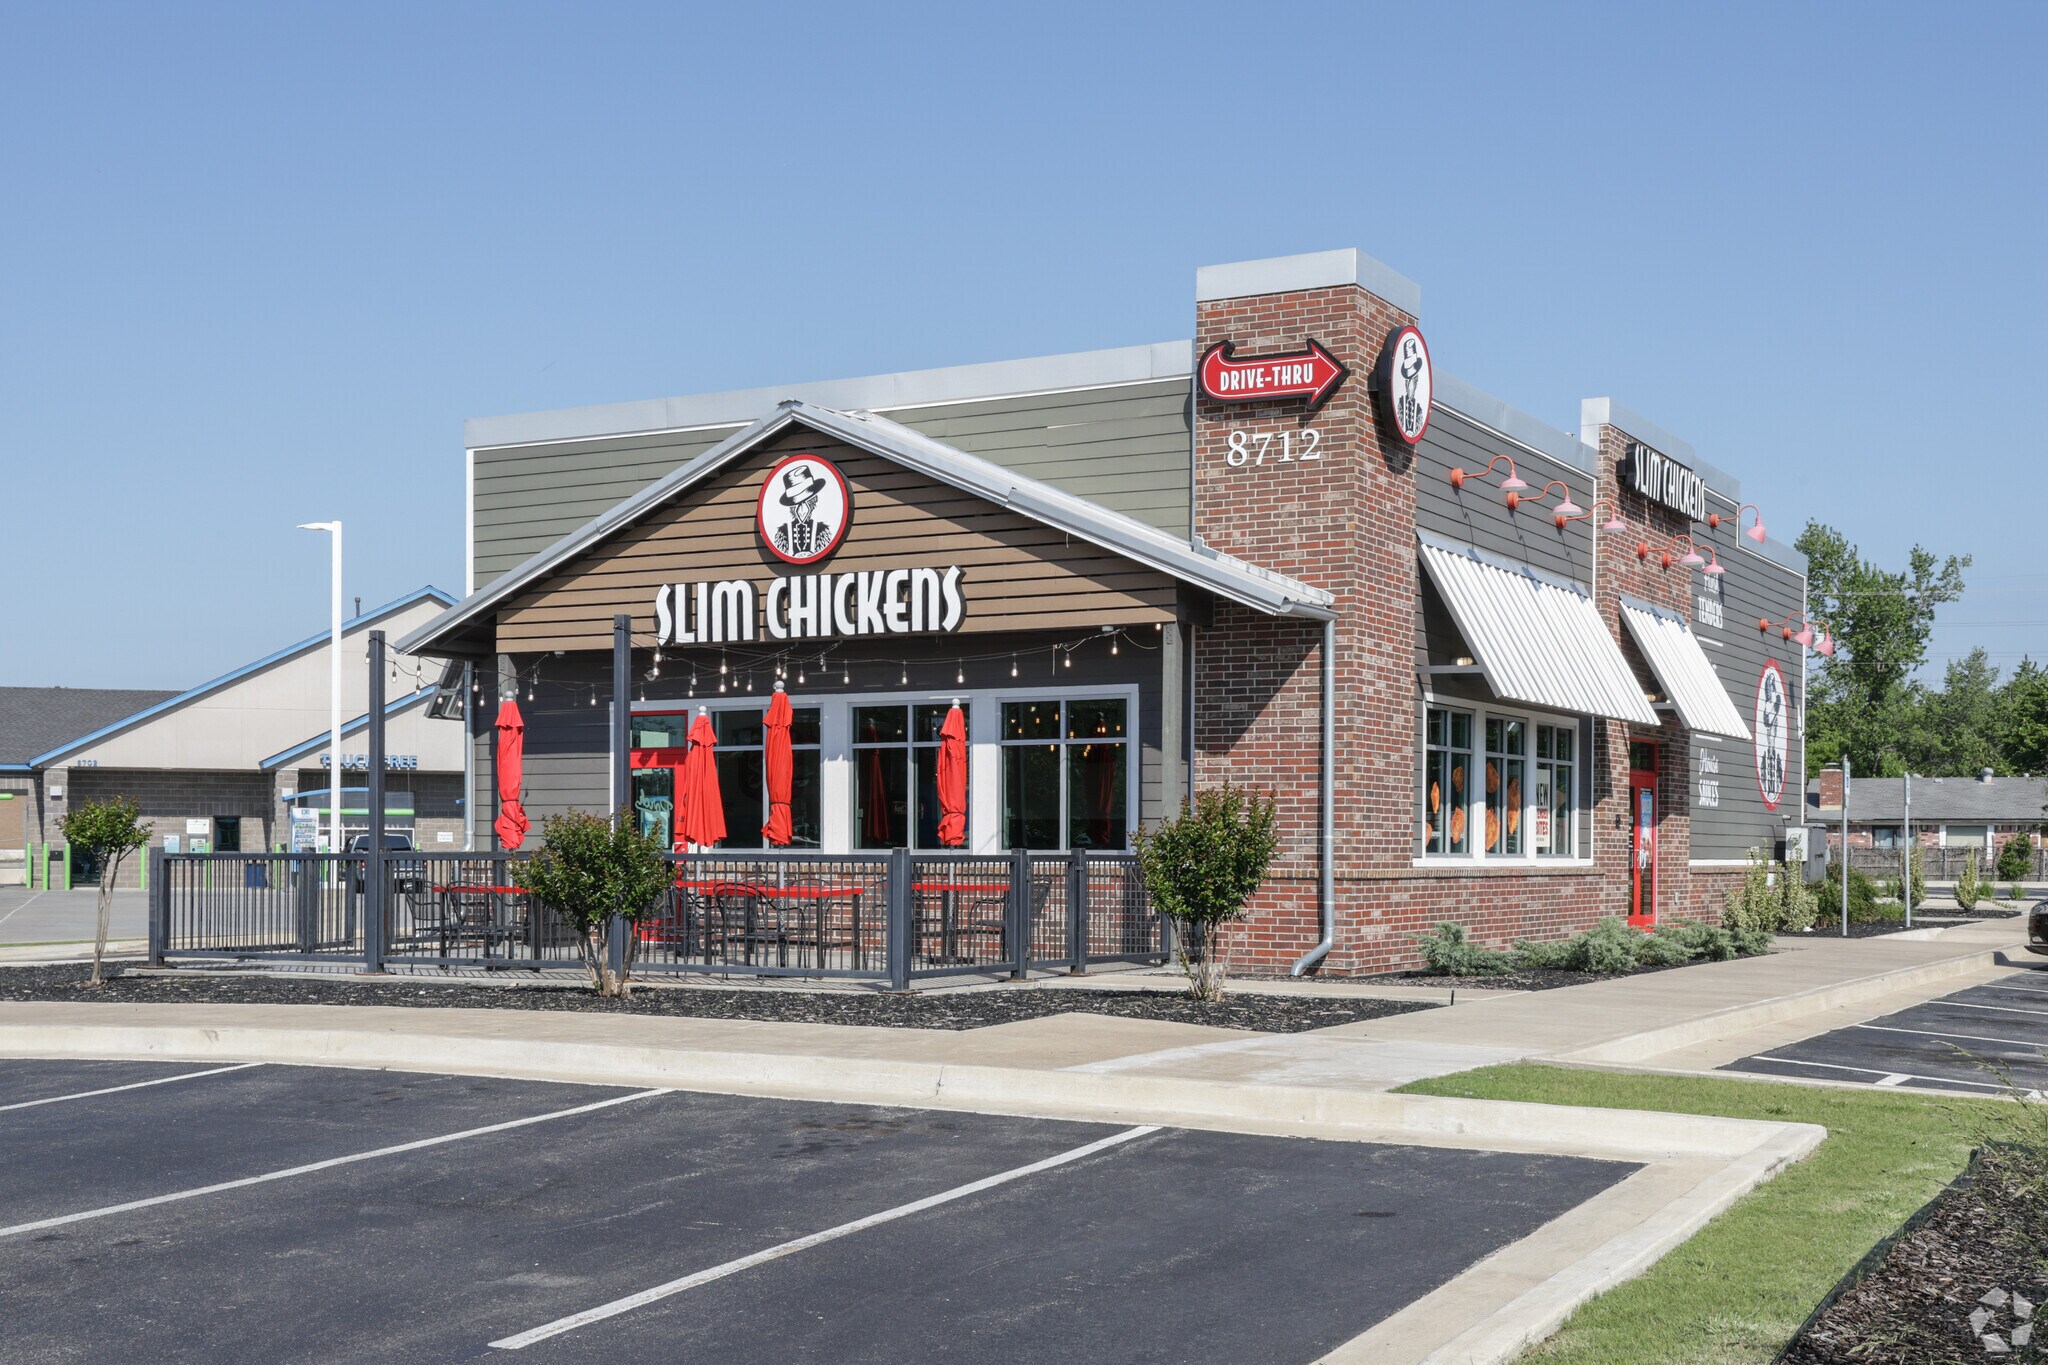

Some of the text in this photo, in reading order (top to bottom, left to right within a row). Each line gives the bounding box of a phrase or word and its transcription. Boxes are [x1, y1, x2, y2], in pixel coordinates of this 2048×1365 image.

[1219, 363, 1314, 392] DRIVE-THRU
[1226, 428, 1321, 467] 8712
[1635, 443, 1705, 522] SLIM CHICKENS
[655, 565, 962, 646] SLIM CHICKENS
[320, 754, 369, 767] TUC
[1536, 783, 1549, 807] NEW
